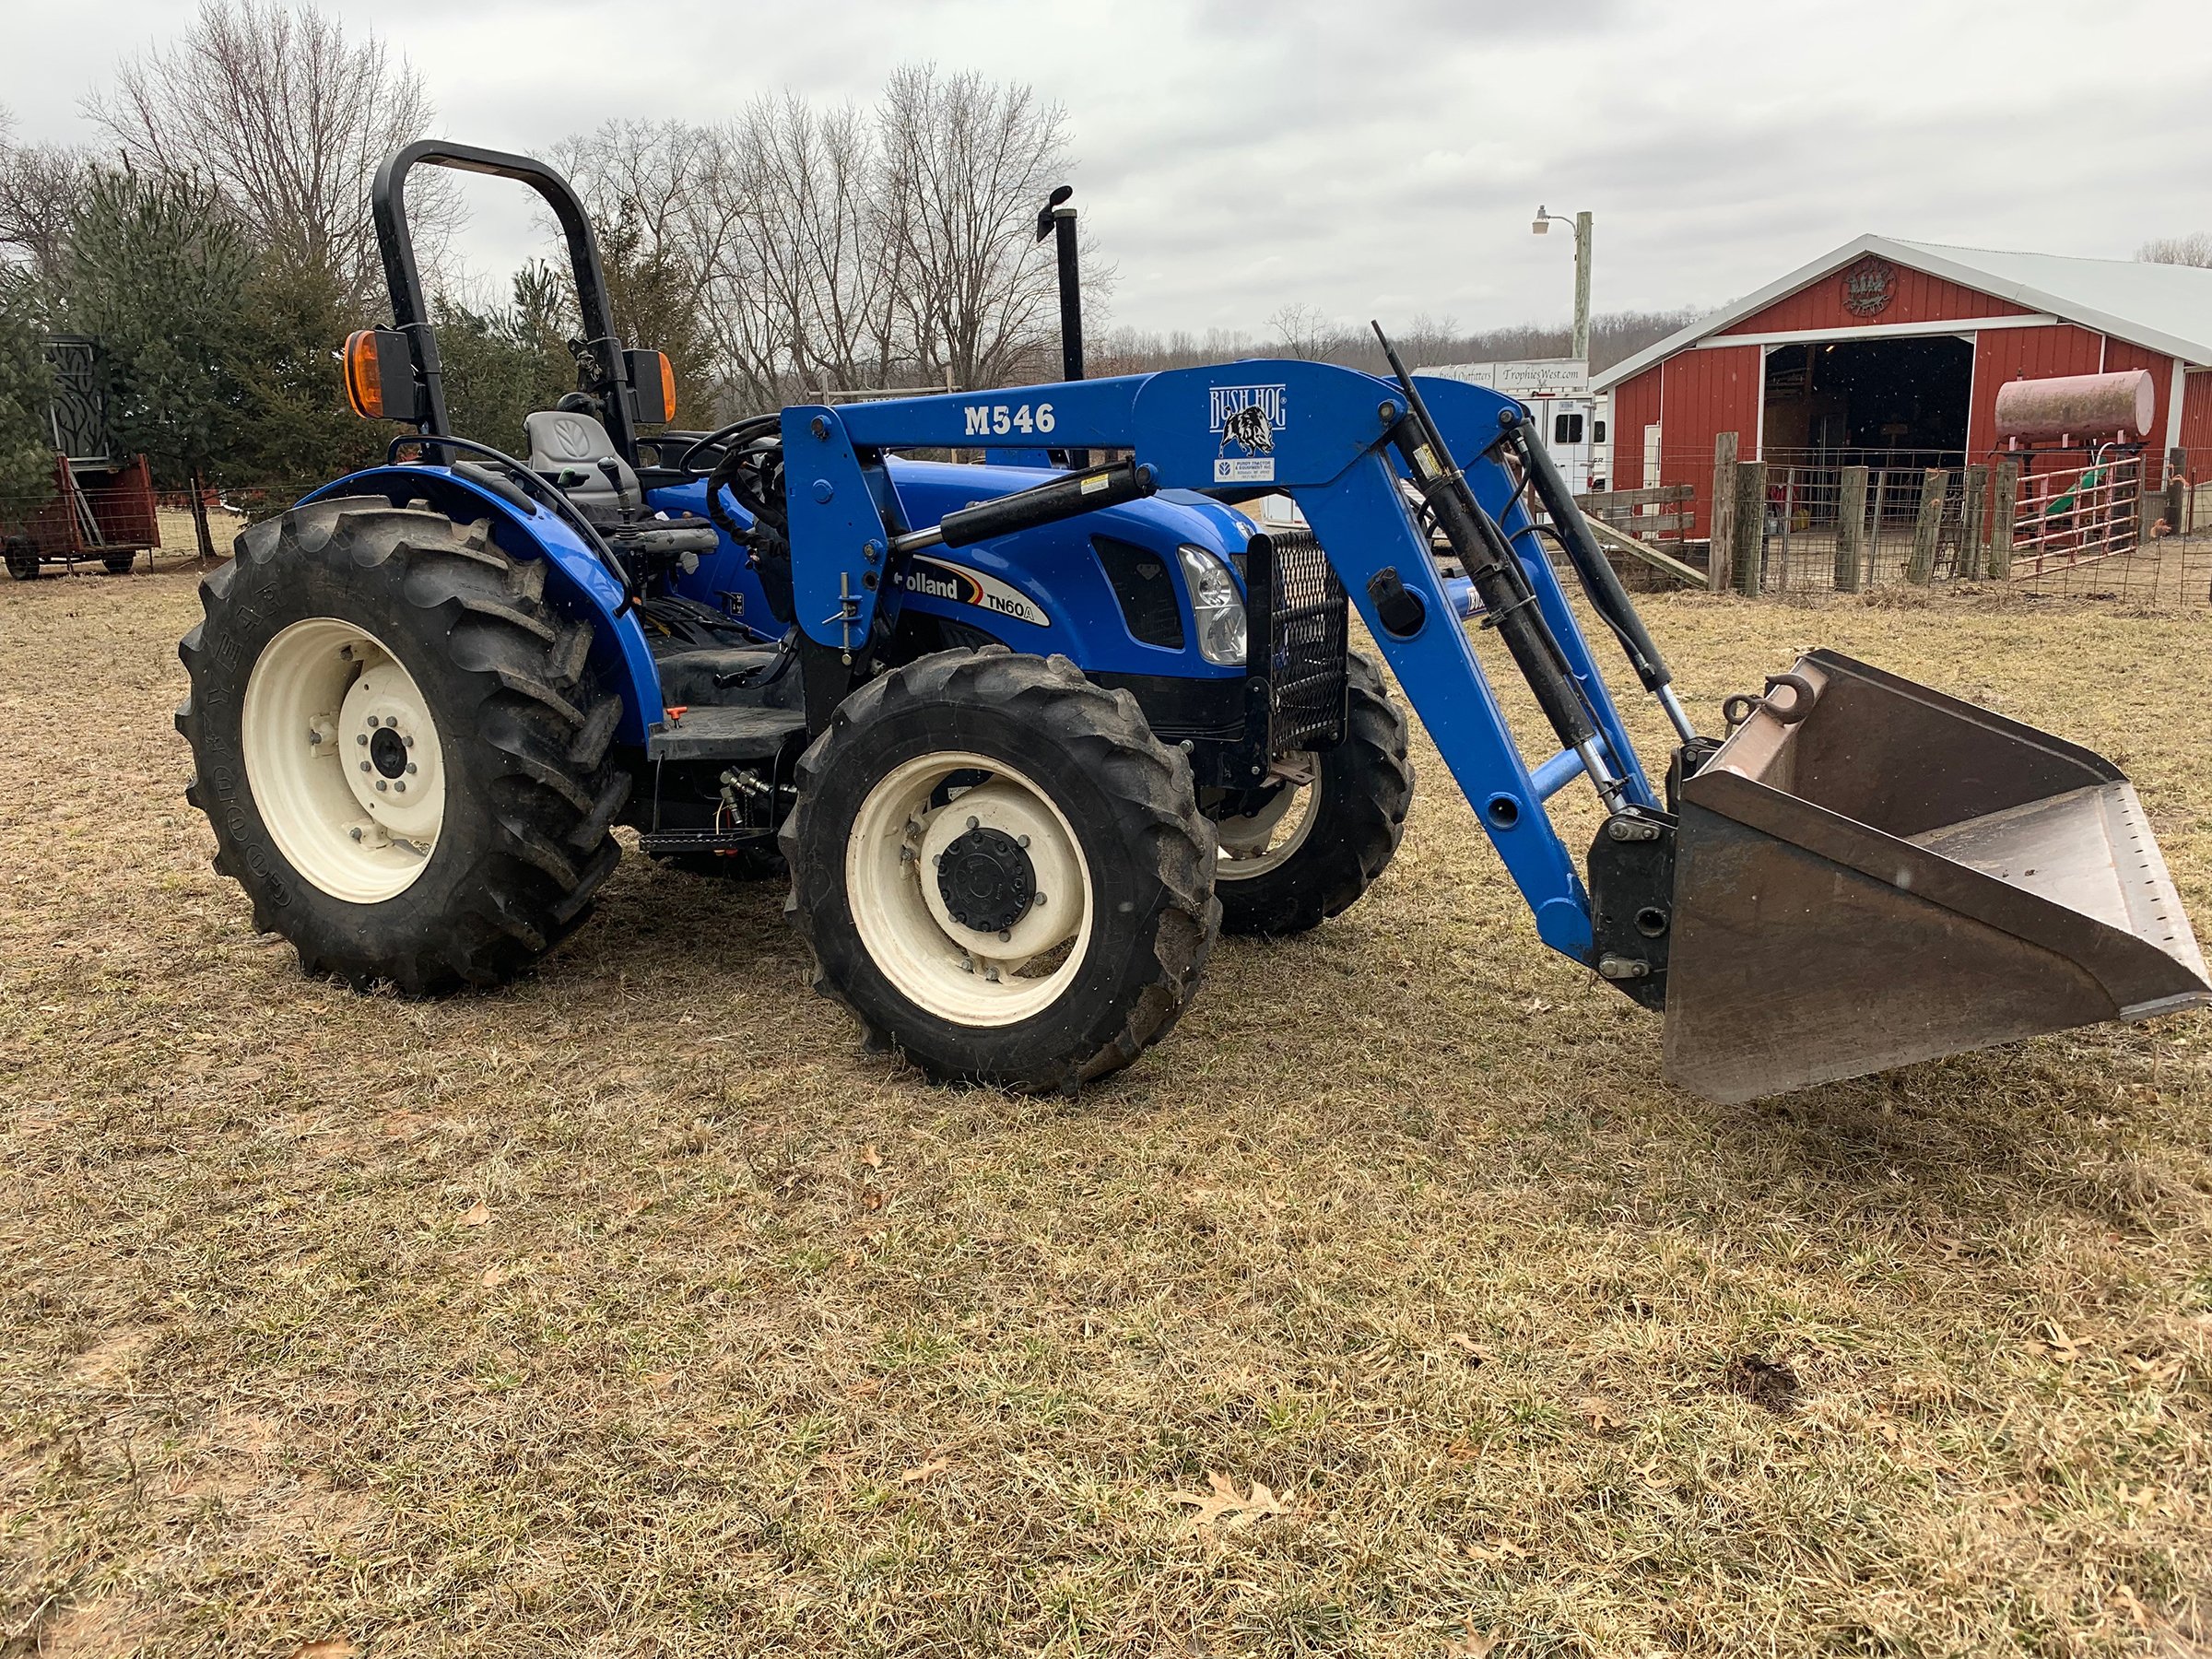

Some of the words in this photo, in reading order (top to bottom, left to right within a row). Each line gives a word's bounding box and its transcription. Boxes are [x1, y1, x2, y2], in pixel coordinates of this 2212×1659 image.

[1459, 369, 1491, 383] Outfitters
[1503, 366, 1579, 385] TrophiesWest.com
[964, 403, 1055, 436] M546
[1209, 389, 1250, 429] BUSH
[1254, 387, 1287, 427] HOG
[987, 594, 1035, 621] TN60A
